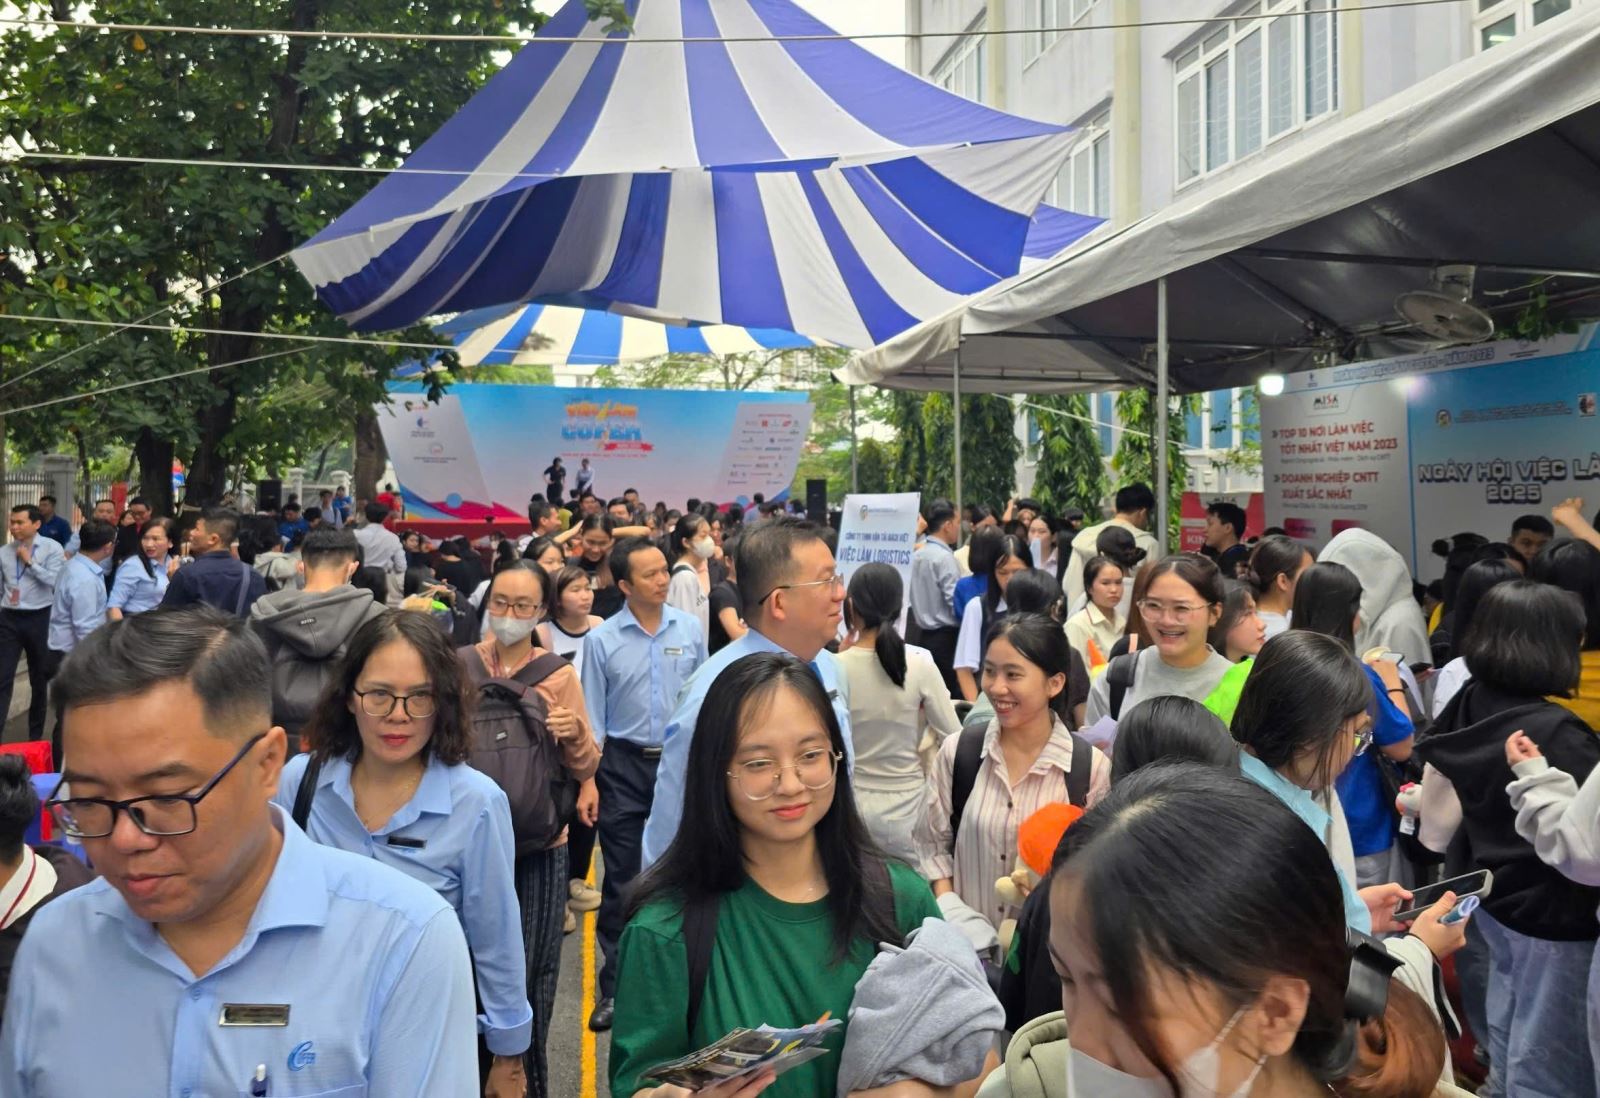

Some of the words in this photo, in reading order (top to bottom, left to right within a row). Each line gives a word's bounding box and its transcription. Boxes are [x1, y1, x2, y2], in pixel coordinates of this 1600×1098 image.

[1279, 428, 1296, 439] TOP
[1299, 427, 1307, 438] 10
[1328, 422, 1348, 436] LÀM
[1350, 420, 1374, 435] VIỆC
[1325, 439, 1345, 454] VIỆT
[1348, 441, 1371, 452] NAM
[1374, 438, 1398, 450] 2023
[1281, 473, 1313, 483] DOANH
[1353, 471, 1379, 483] CNTT
[1418, 458, 1472, 482] NGÀY
[1477, 457, 1512, 483] HỘI
[1516, 456, 1567, 484] VIỆC
[1326, 486, 1353, 500] NHẤT
[1486, 483, 1542, 504] 2025
[840, 545, 856, 564] VIỆC
[857, 545, 872, 562] LÀM
[873, 549, 911, 566] LOGISTICS
